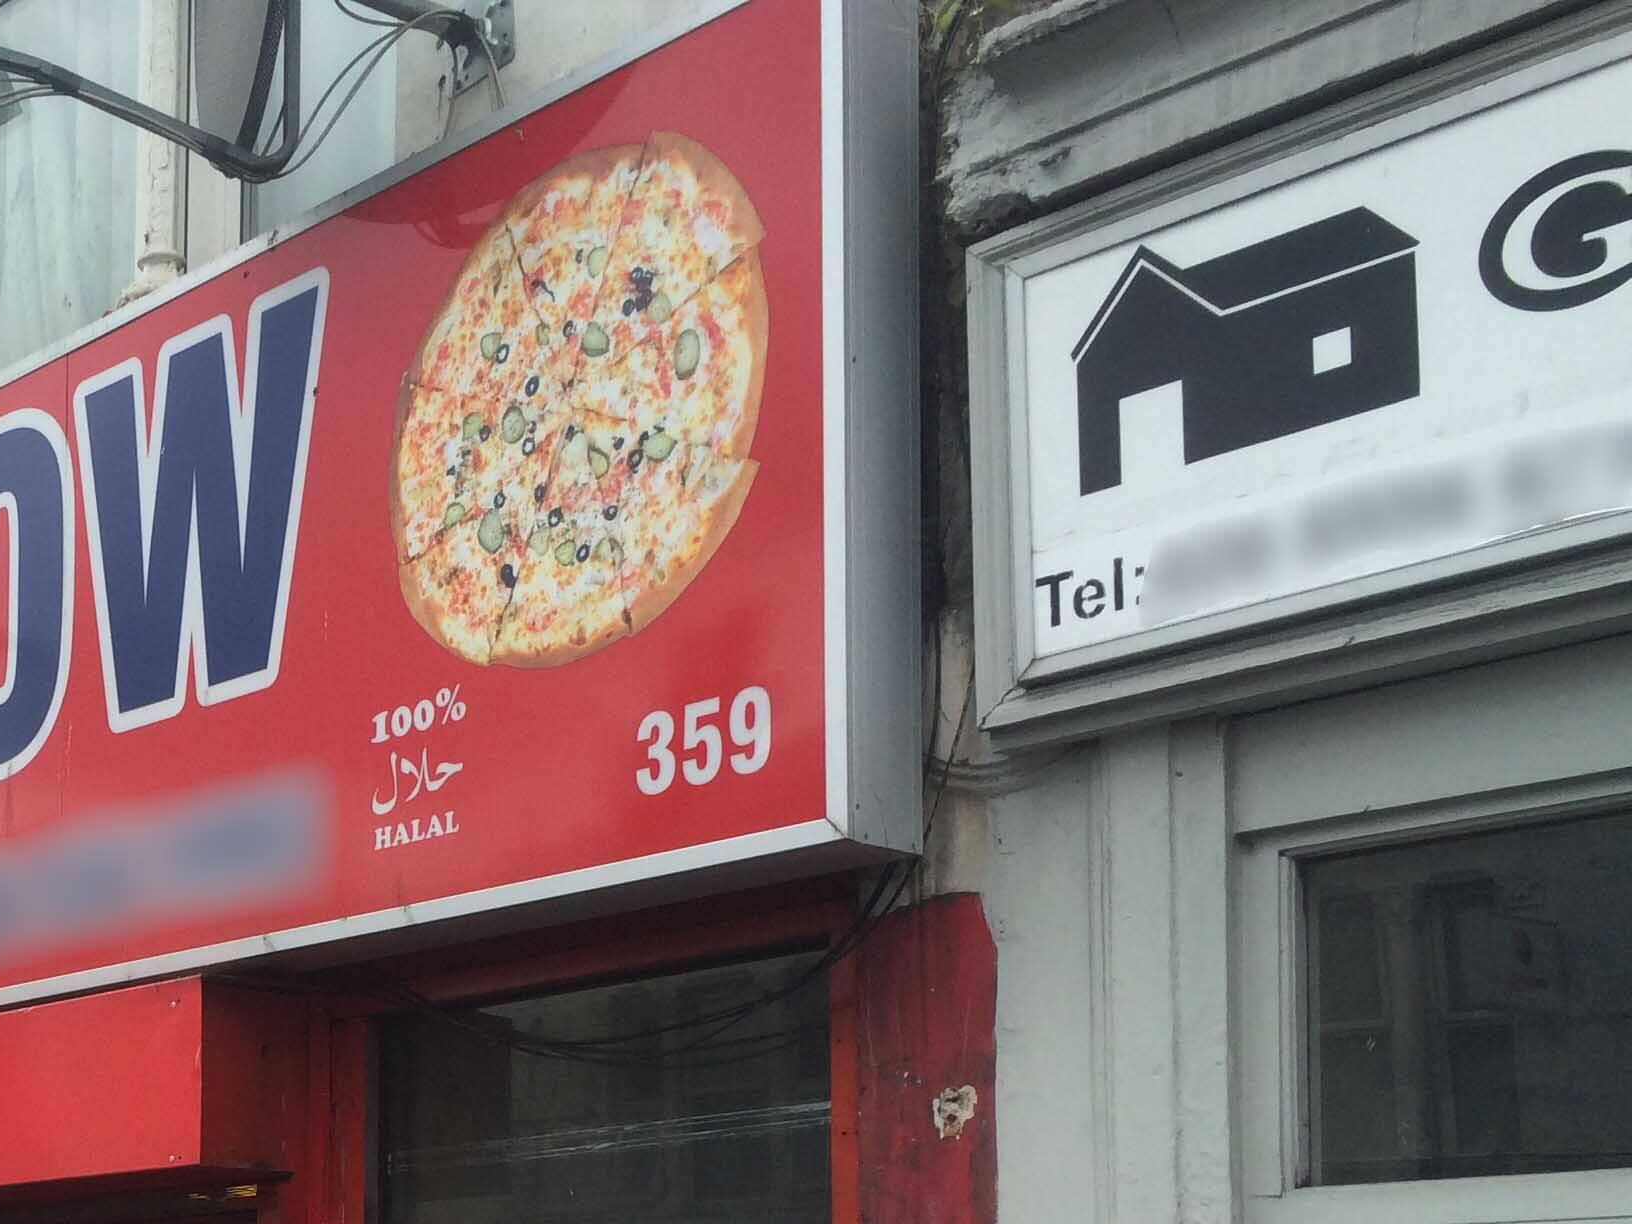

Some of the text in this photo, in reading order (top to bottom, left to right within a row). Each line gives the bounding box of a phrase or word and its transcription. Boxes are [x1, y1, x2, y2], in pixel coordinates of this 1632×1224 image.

[370, 684, 467, 743] 100%
[635, 685, 772, 796] 359
[372, 747, 463, 815] حلال
[374, 810, 459, 851] HALAL
